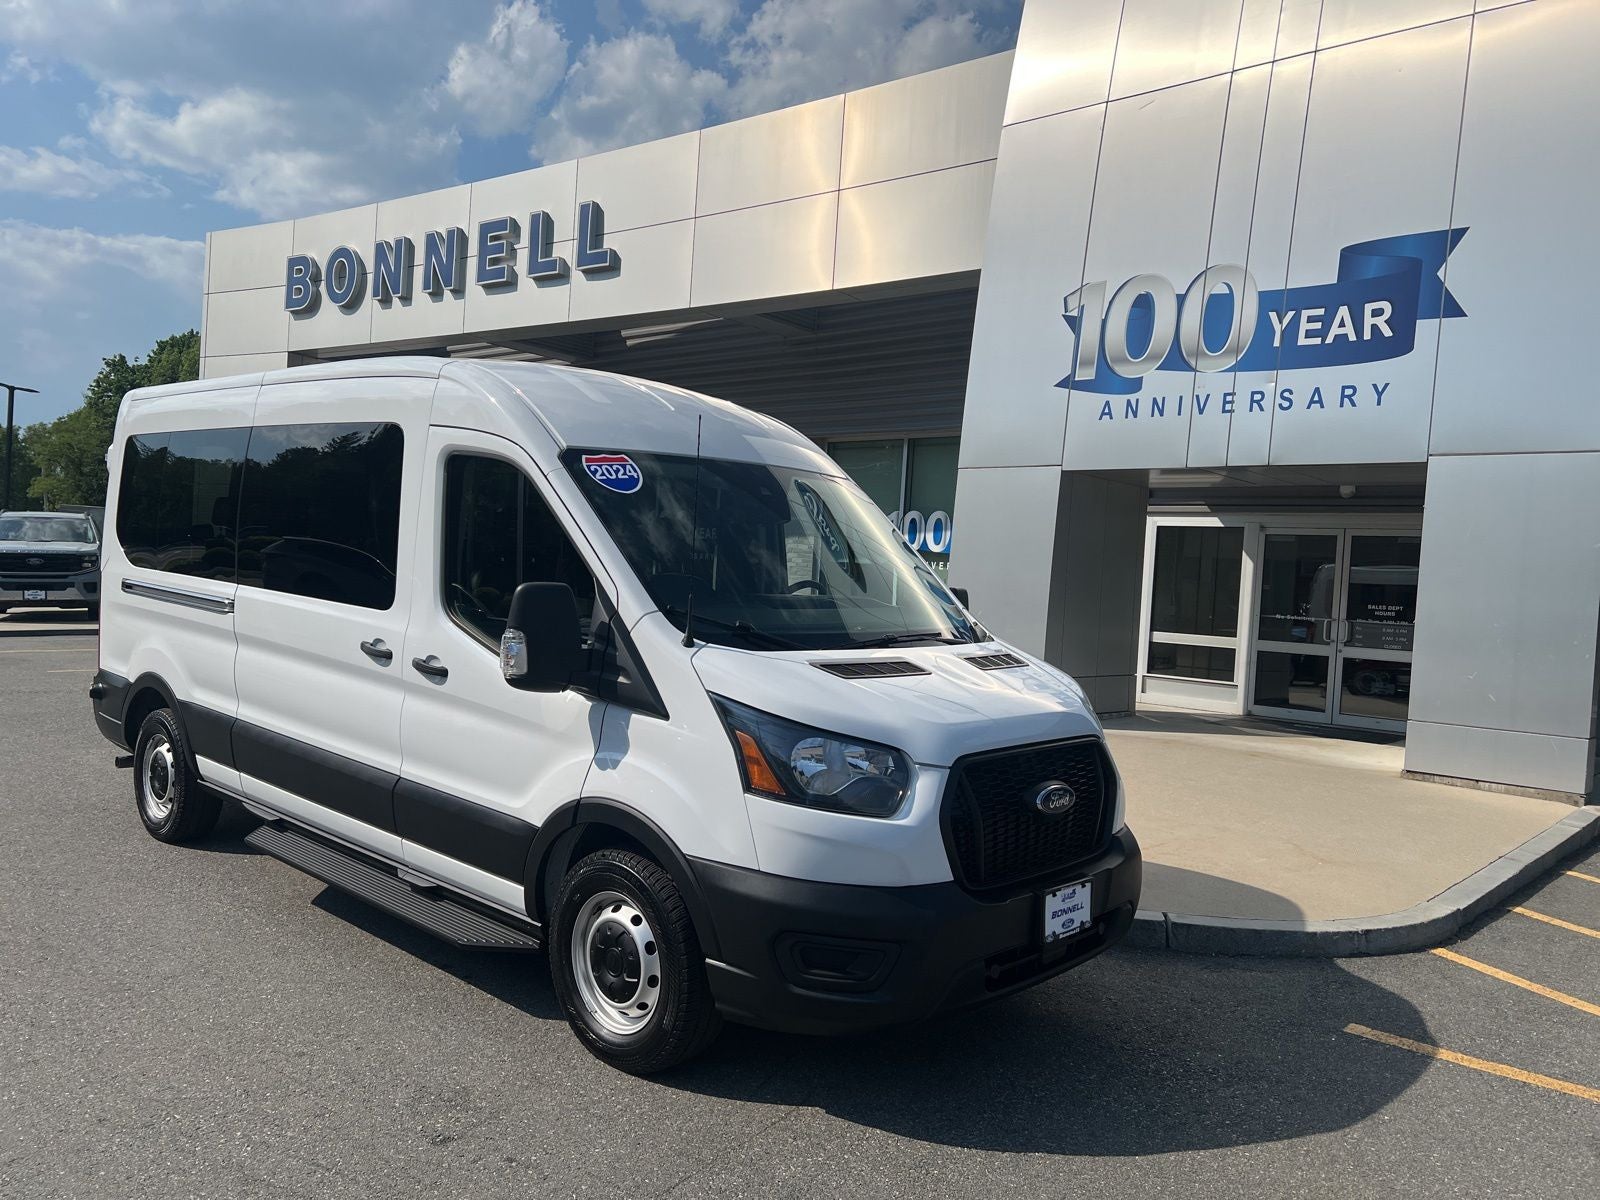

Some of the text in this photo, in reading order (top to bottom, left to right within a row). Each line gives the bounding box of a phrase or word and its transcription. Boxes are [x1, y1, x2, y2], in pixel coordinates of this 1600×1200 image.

[284, 200, 618, 313] BONNELL
[1063, 263, 1394, 381] 100 YEAR
[1098, 382, 1391, 421] ANNIVERSARY
[590, 464, 639, 480] 2024
[1051, 902, 1085, 920] BONNELL
